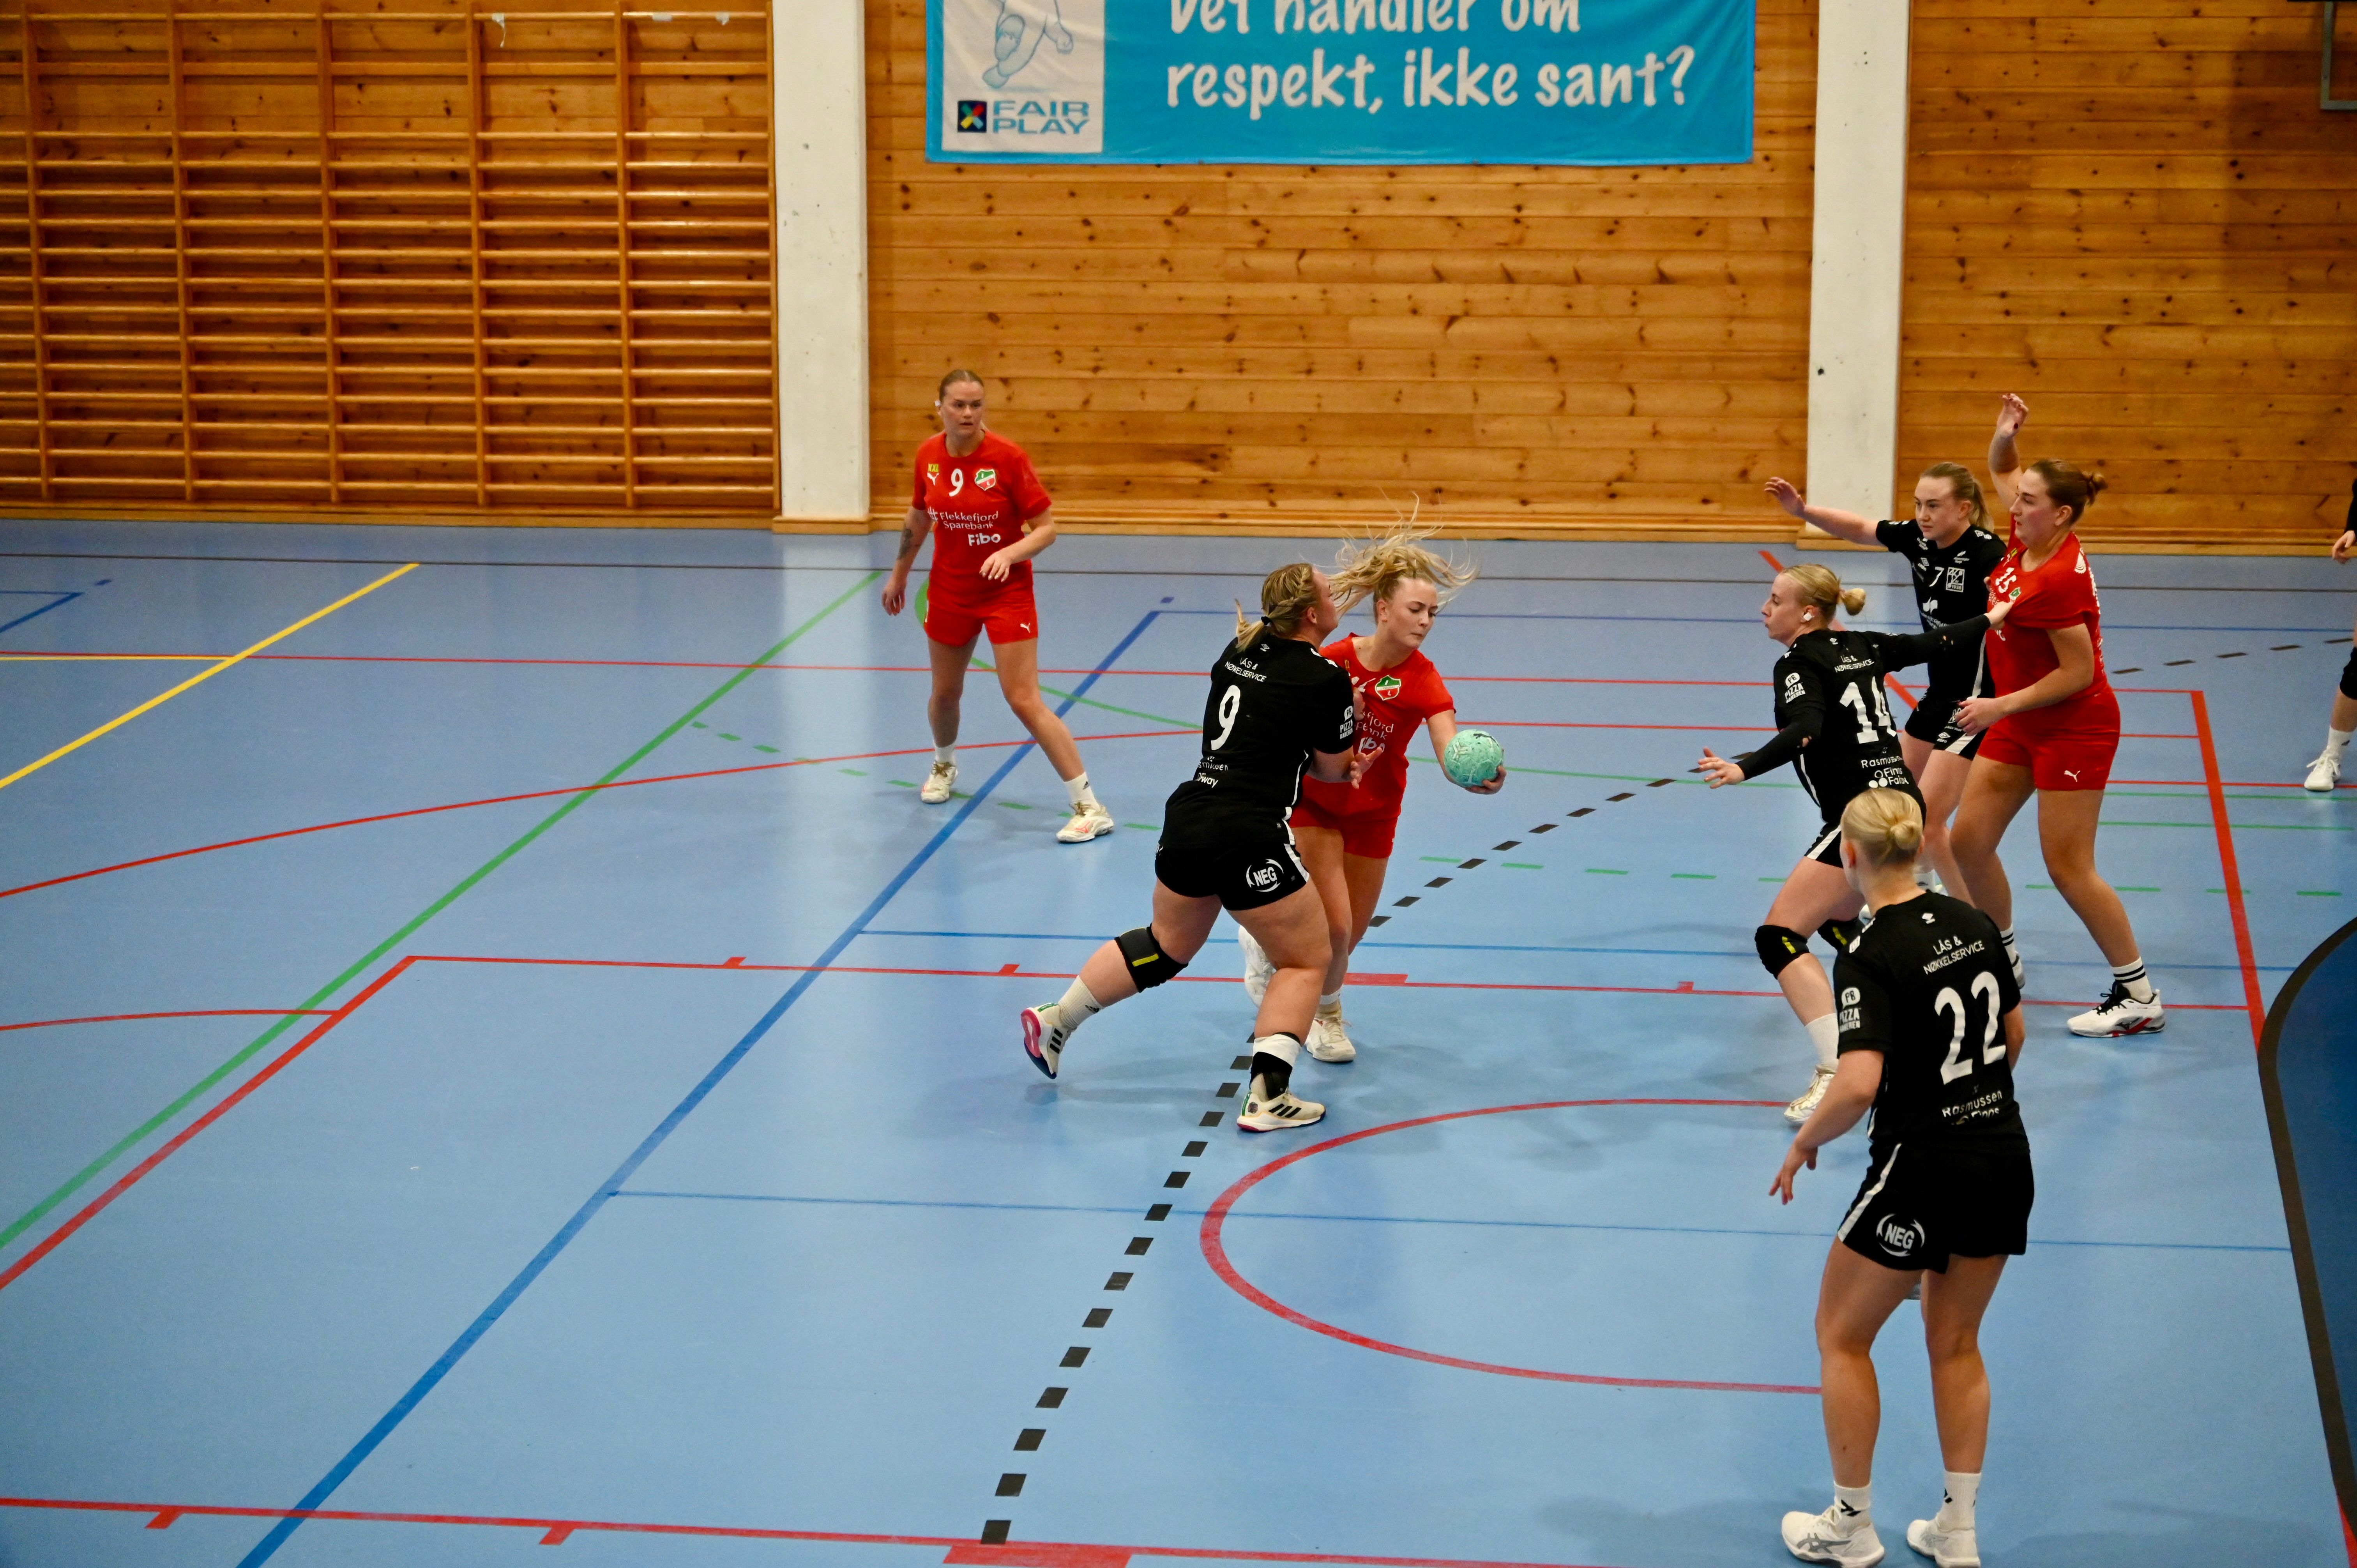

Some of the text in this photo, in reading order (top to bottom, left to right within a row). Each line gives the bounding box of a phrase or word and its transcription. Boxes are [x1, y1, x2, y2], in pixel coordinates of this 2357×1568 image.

[1501, 0, 1581, 33] om
[1168, 45, 1695, 120] respekt, ikke sant?
[993, 101, 1090, 117] FAIR
[993, 118, 1090, 134] PLAY
[949, 469, 963, 497] 9
[940, 511, 998, 523] Flekkefjord
[943, 521, 993, 531] Sparebank
[968, 533, 1001, 546] Fibo
[1929, 566, 1945, 587] 7
[1788, 675, 1797, 683] PB
[1785, 683, 1804, 700] PIZZA
[1210, 685, 1240, 750] 9
[1253, 867, 1277, 886] NEG
[1933, 936, 1963, 955] LÅS &
[1923, 940, 1985, 975] NØKKELSERVICE
[1845, 991, 1856, 1003] PB
[1935, 971, 2006, 1085] 22
[1942, 1090, 2003, 1118] Rasmussen
[1884, 1223, 1915, 1249] NEG
